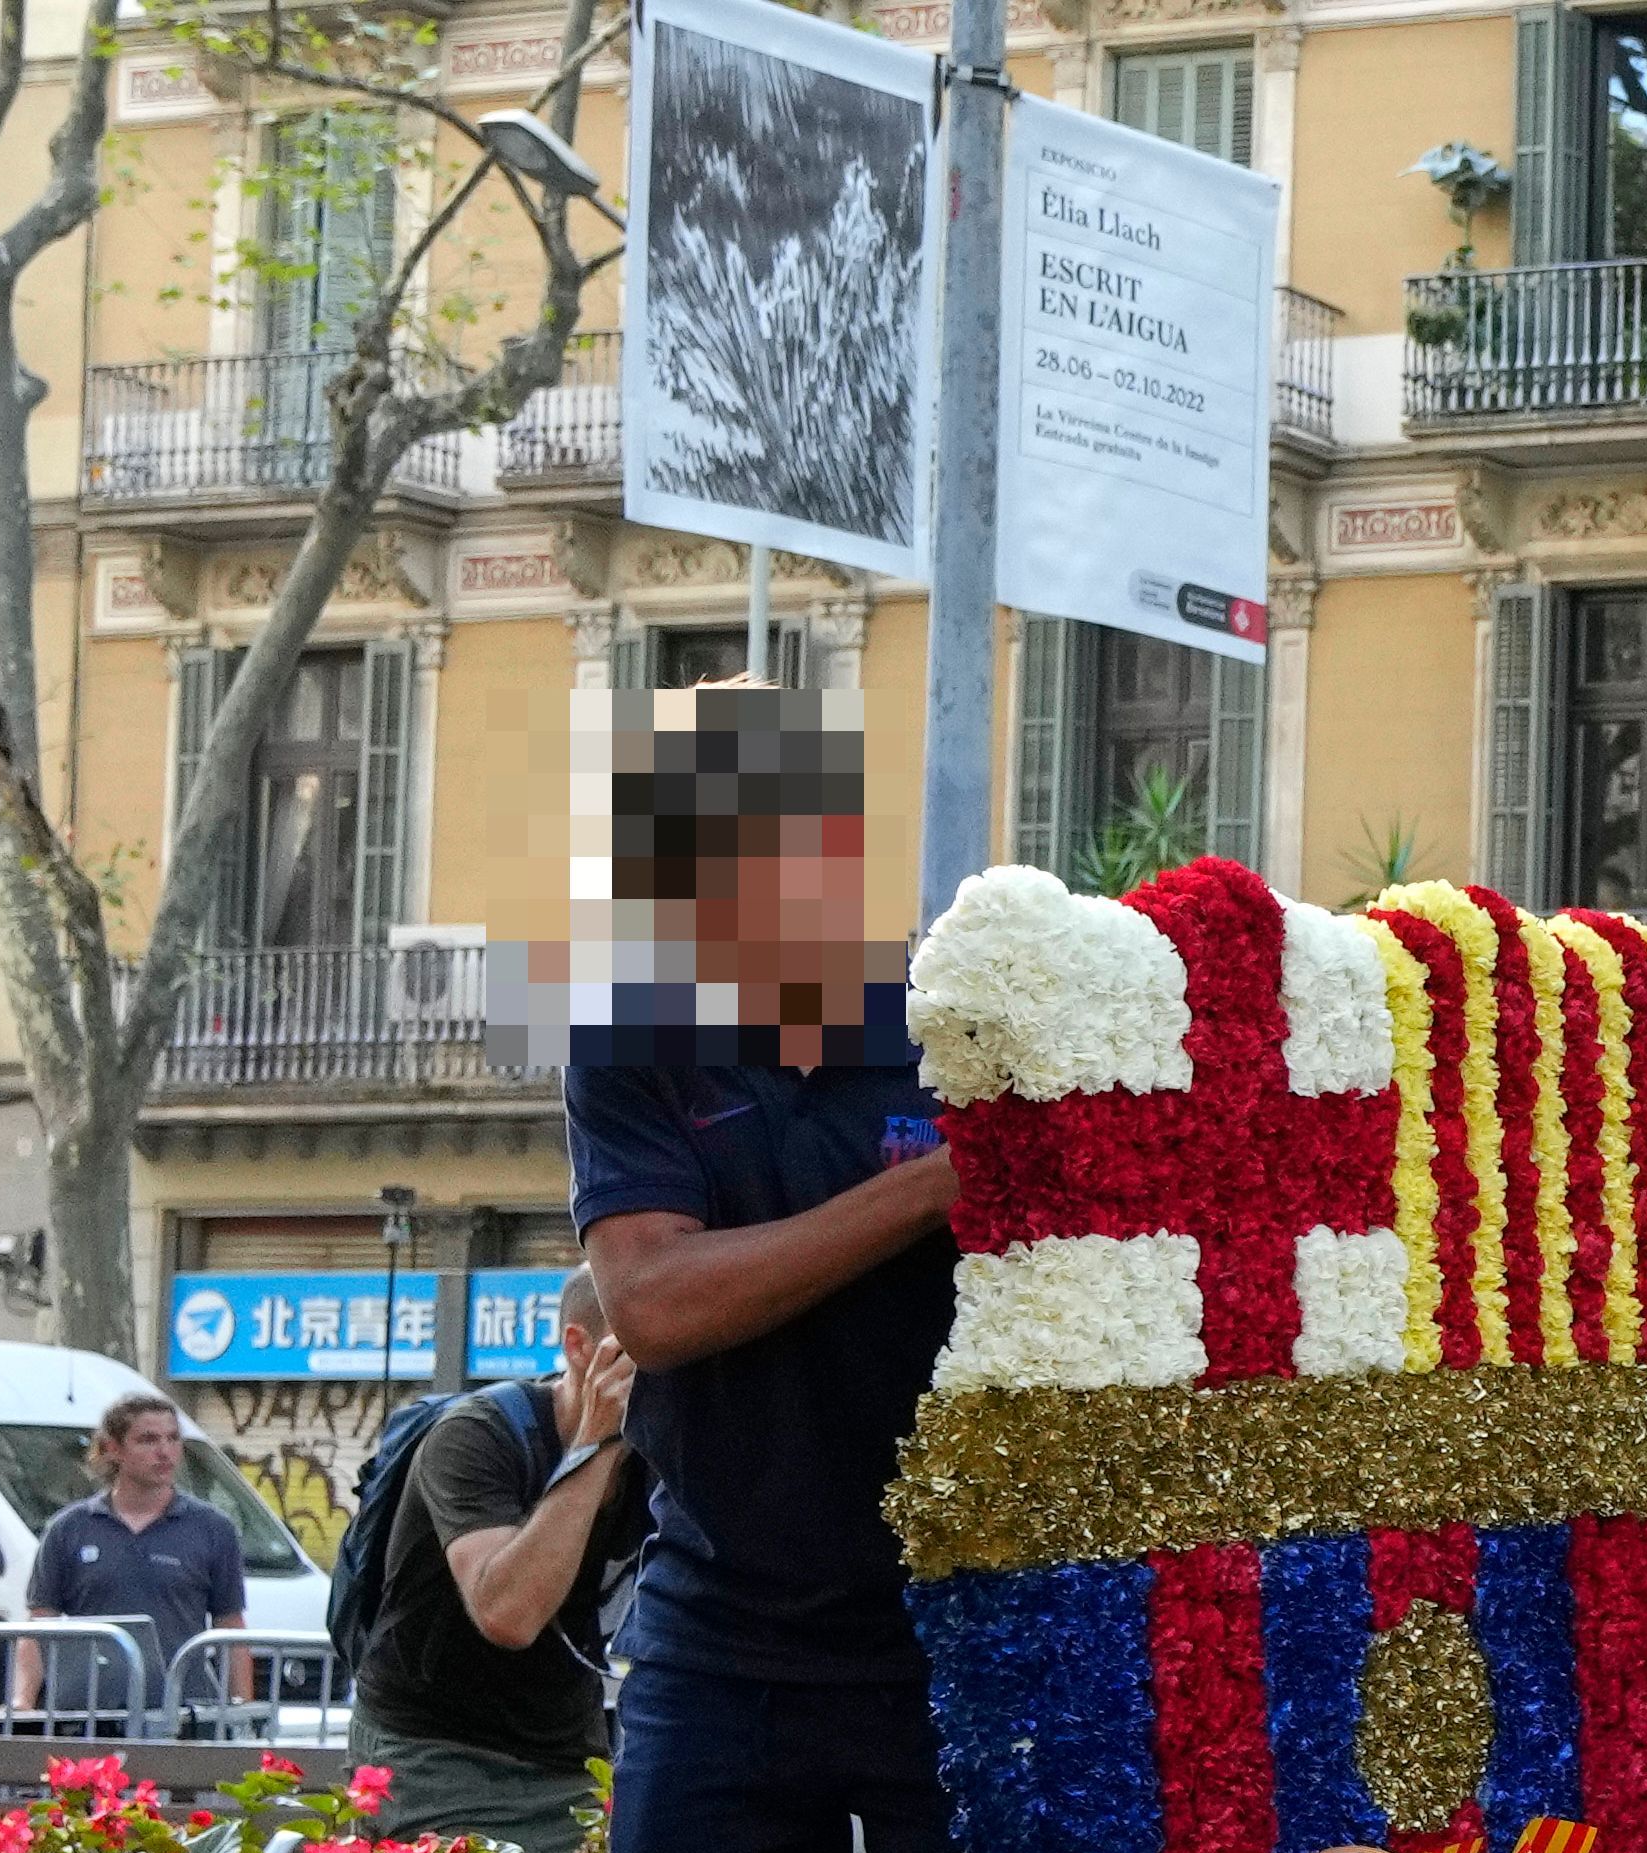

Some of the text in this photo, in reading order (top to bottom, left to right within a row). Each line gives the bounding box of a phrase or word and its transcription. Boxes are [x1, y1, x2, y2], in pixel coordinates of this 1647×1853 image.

[1099, 208, 1161, 250] Llach
[1041, 252, 1142, 301] ESCRIT
[1040, 287, 1188, 353] EN L'AIGUA
[1036, 349, 1092, 380] 28.06
[1114, 368, 1205, 412] 02.10.2022
[254, 1295, 436, 1349] 北京青年
